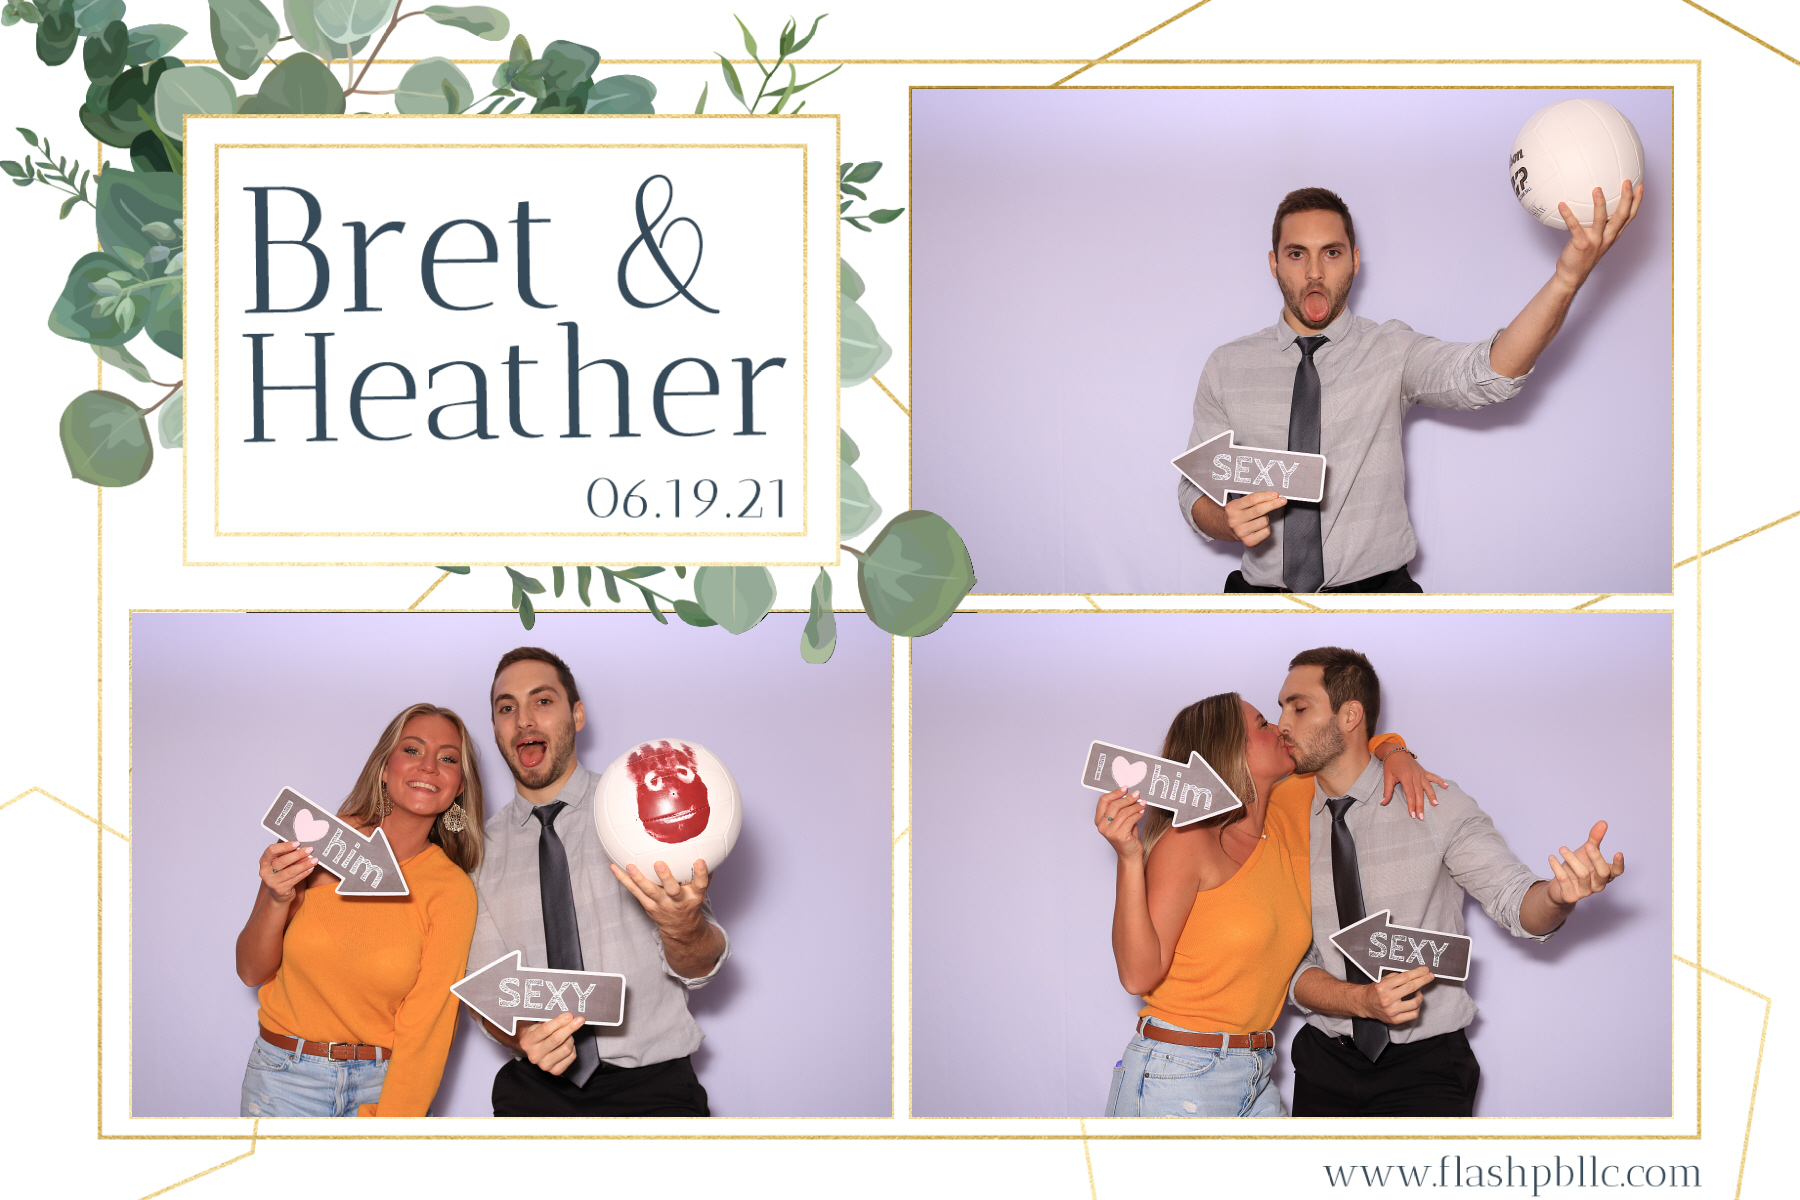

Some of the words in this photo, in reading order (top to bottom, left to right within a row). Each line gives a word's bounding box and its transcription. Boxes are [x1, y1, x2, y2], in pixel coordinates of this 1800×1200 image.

[1212, 453, 1300, 489] SEXY
[1094, 753, 1107, 781] I
[1148, 763, 1213, 811] him
[275, 799, 294, 826] I
[321, 827, 384, 889] him
[1368, 931, 1450, 968] SEXY
[498, 977, 597, 1013] SEXY
